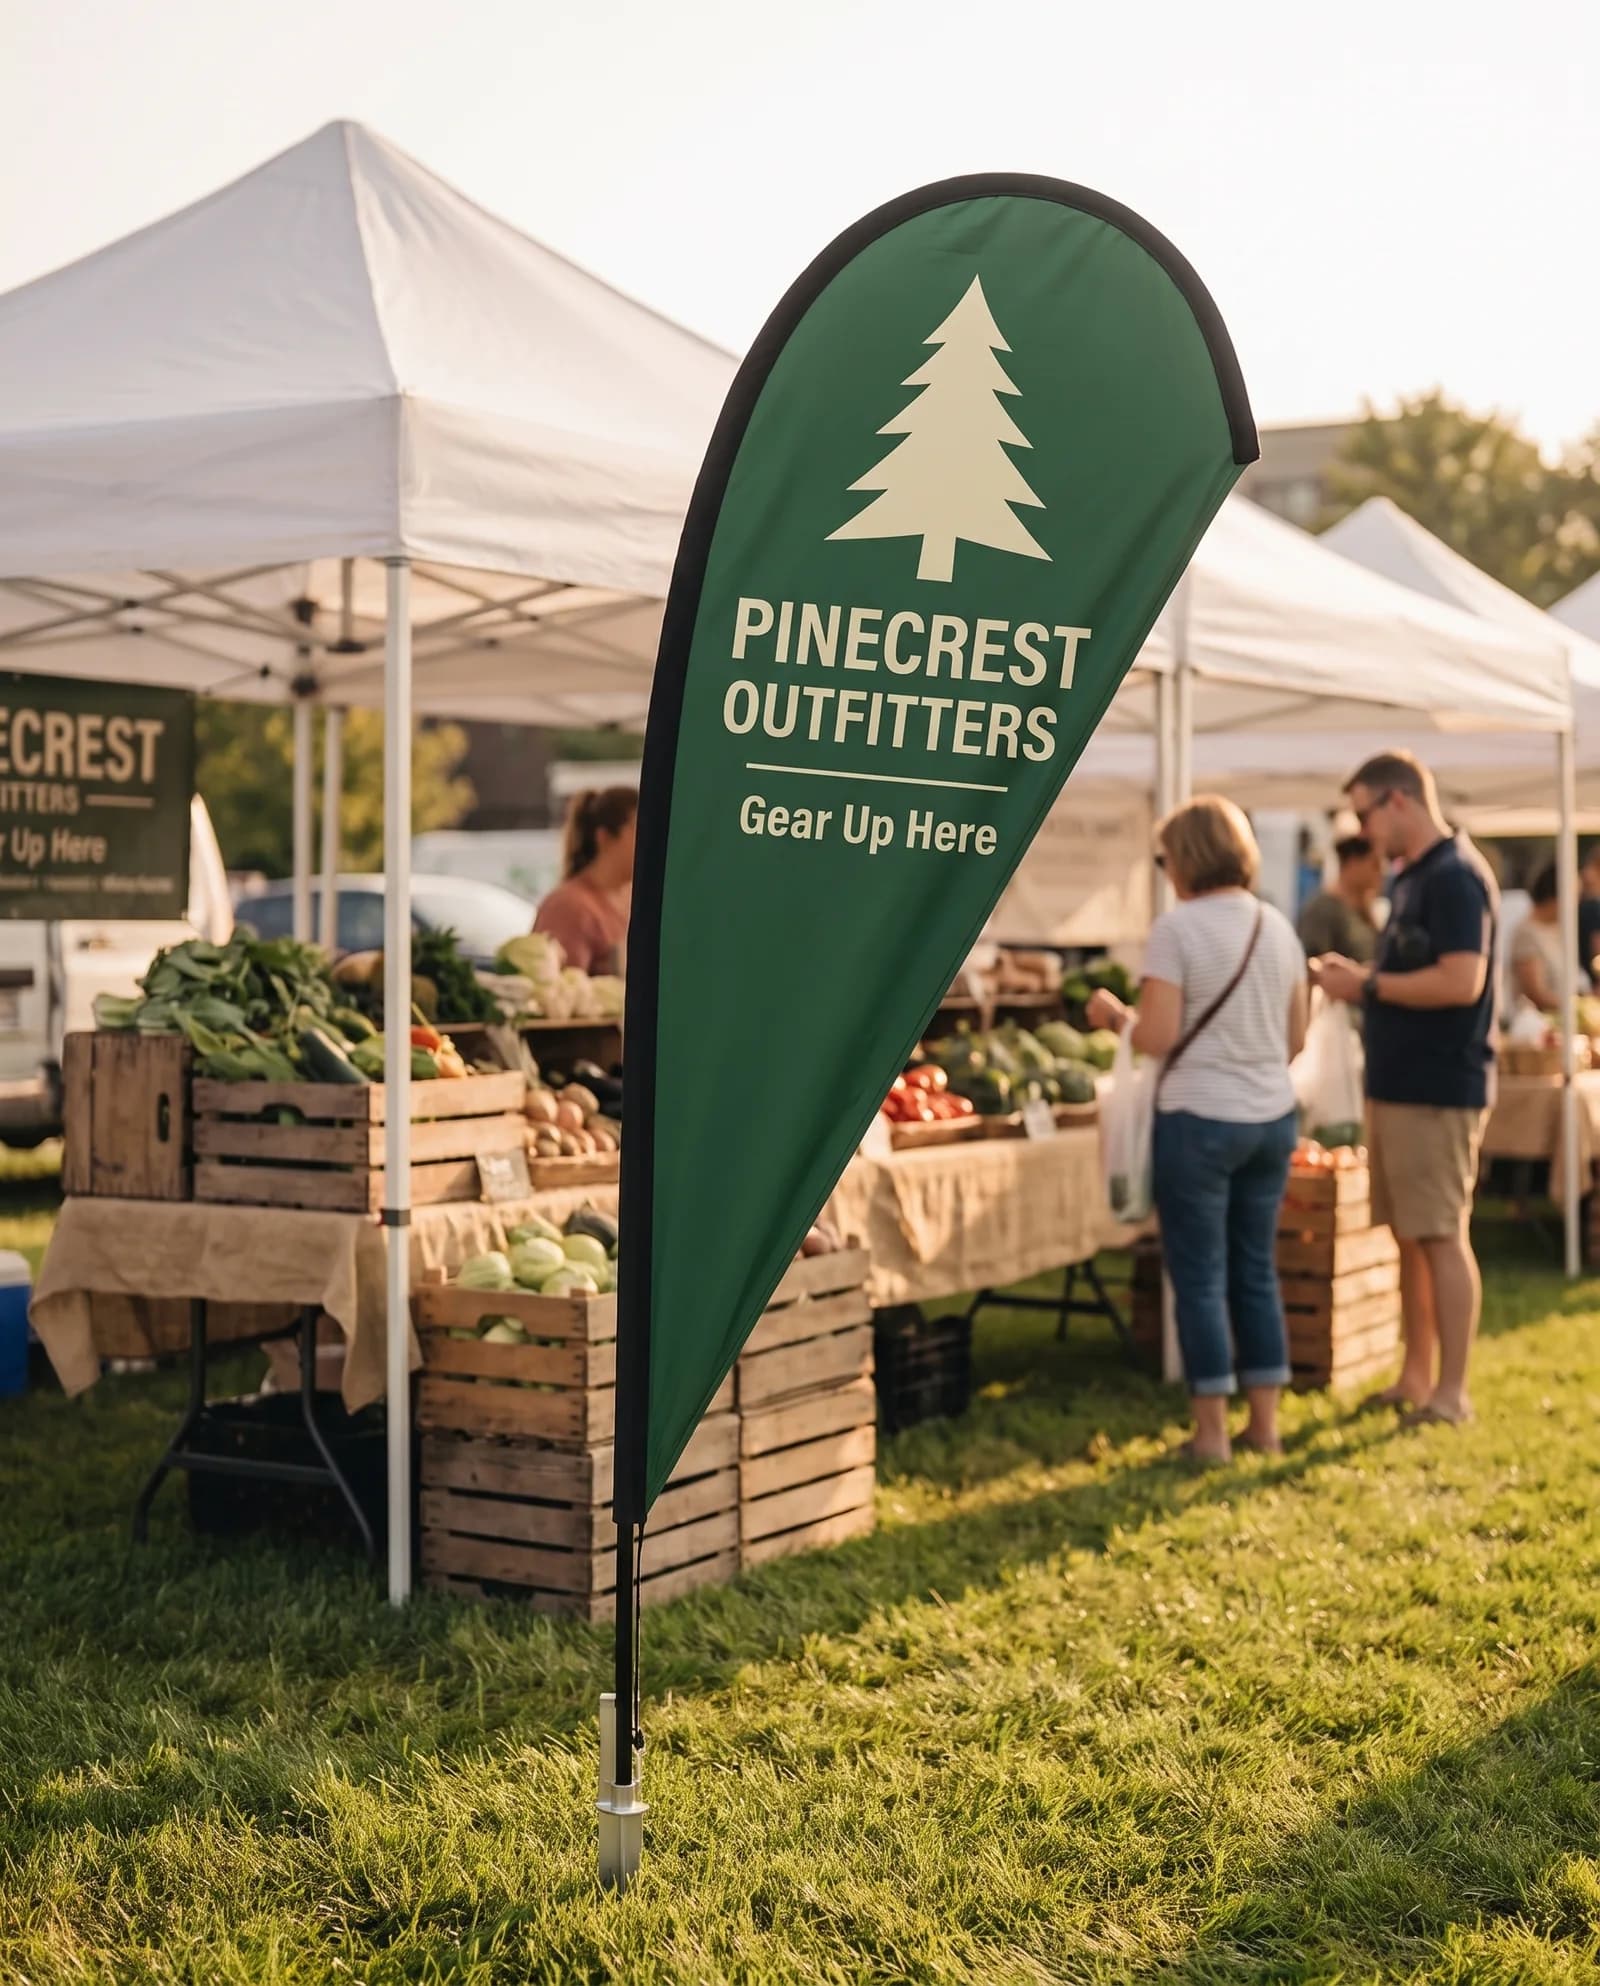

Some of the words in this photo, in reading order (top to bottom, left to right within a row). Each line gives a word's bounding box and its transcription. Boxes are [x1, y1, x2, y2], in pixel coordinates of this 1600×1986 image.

[731, 597, 1092, 690] PINECREST
[723, 679, 1058, 762] OUTFITTERS
[11, 827, 46, 869] Up
[50, 828, 108, 864] Here
[740, 795, 833, 840] Gear
[843, 804, 894, 855] Up
[906, 809, 997, 856] Here
